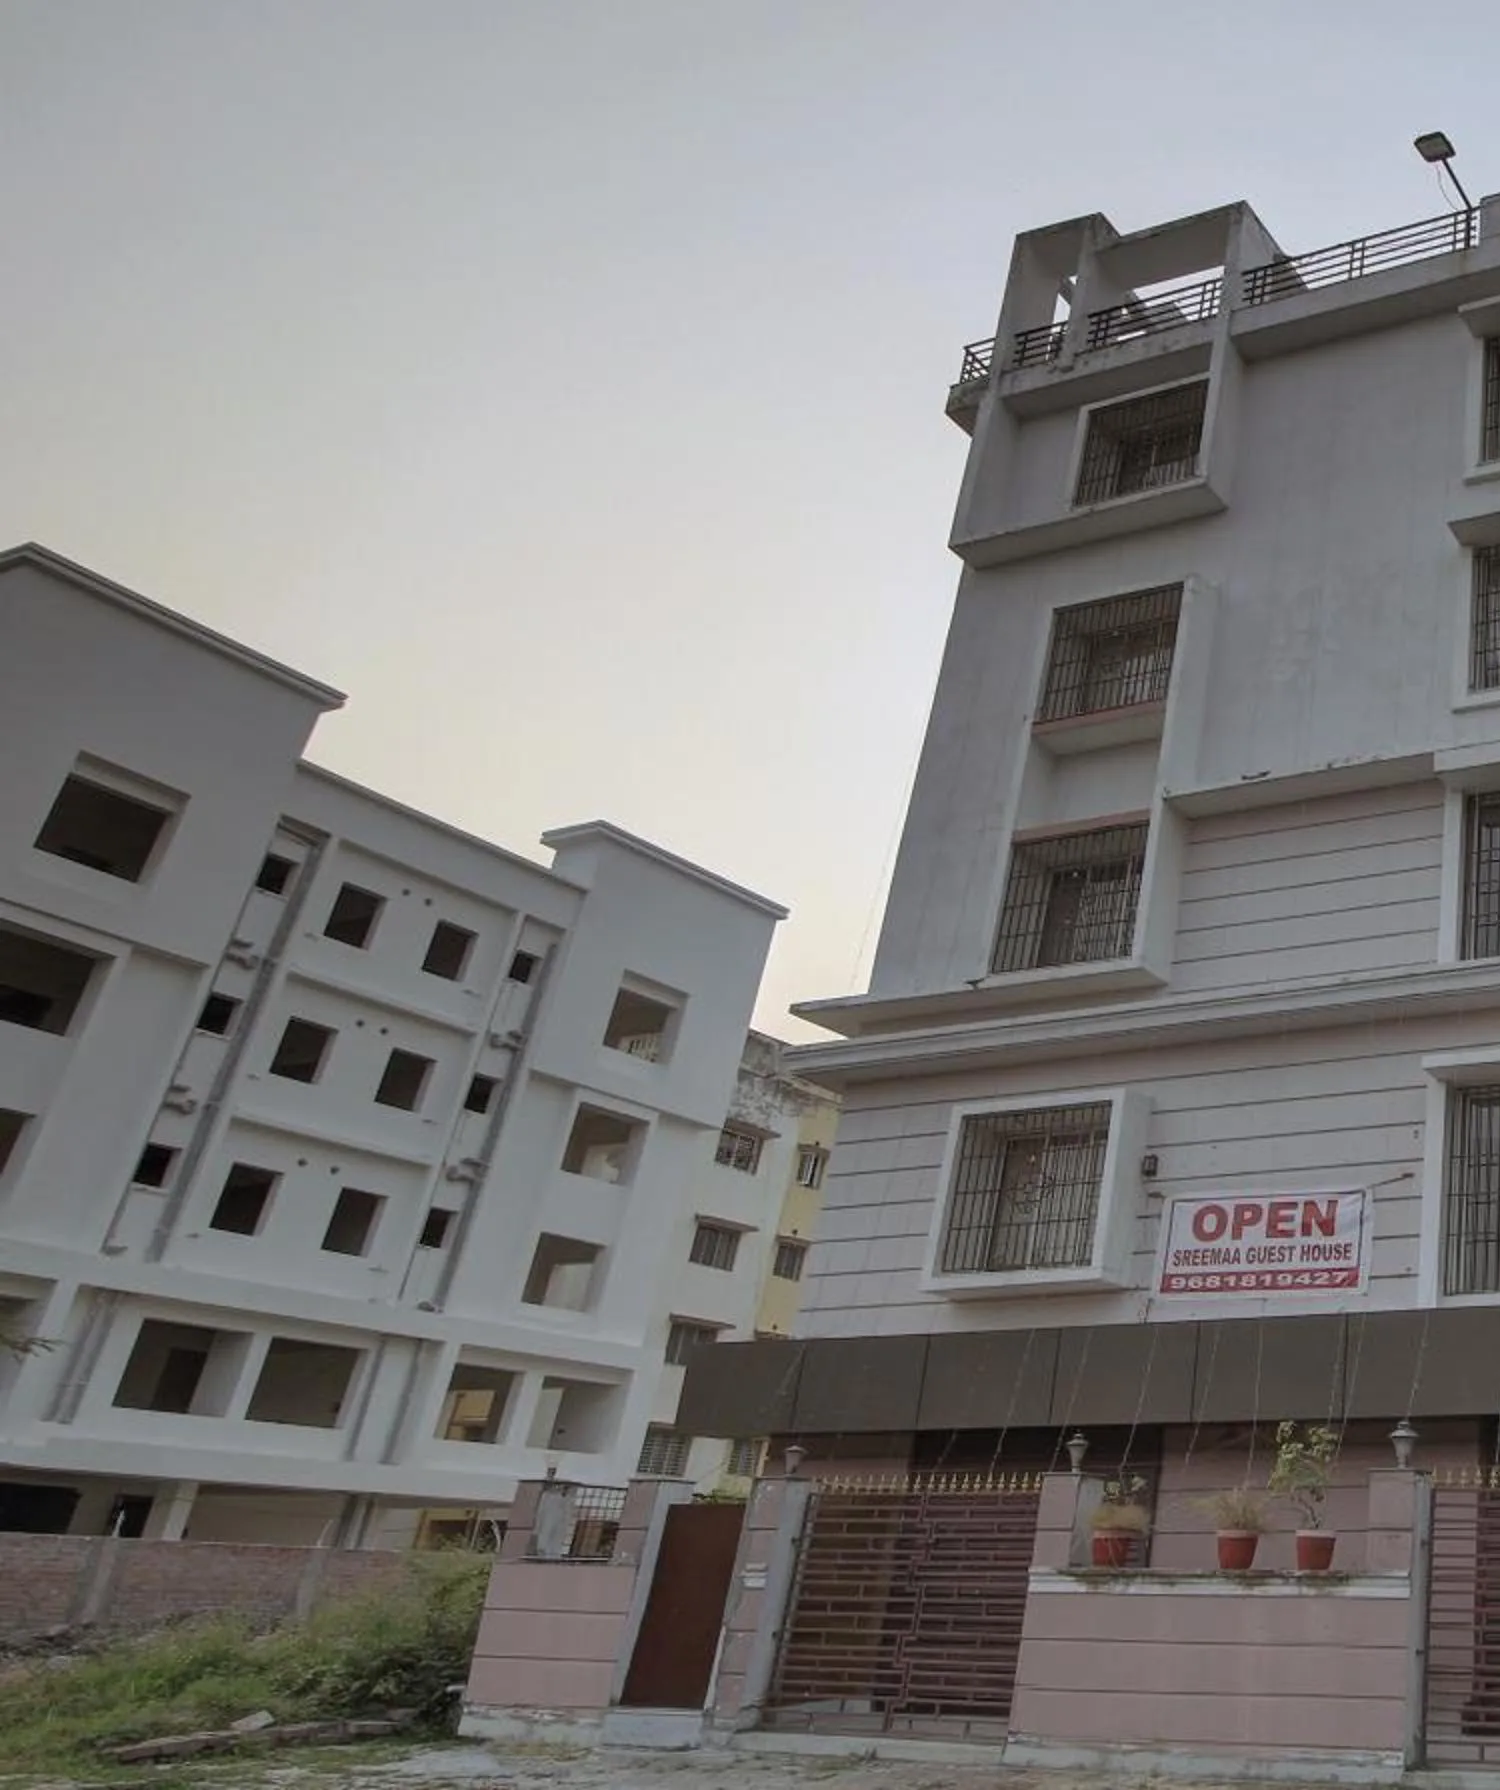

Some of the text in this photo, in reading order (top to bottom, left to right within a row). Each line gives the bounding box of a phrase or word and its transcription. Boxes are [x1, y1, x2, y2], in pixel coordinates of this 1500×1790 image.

[1191, 1200, 1339, 1242] OPEN
[1172, 1243, 1353, 1267] SREEMAA GUEST HOUSE
[1170, 1273, 1349, 1289] 9681819427
